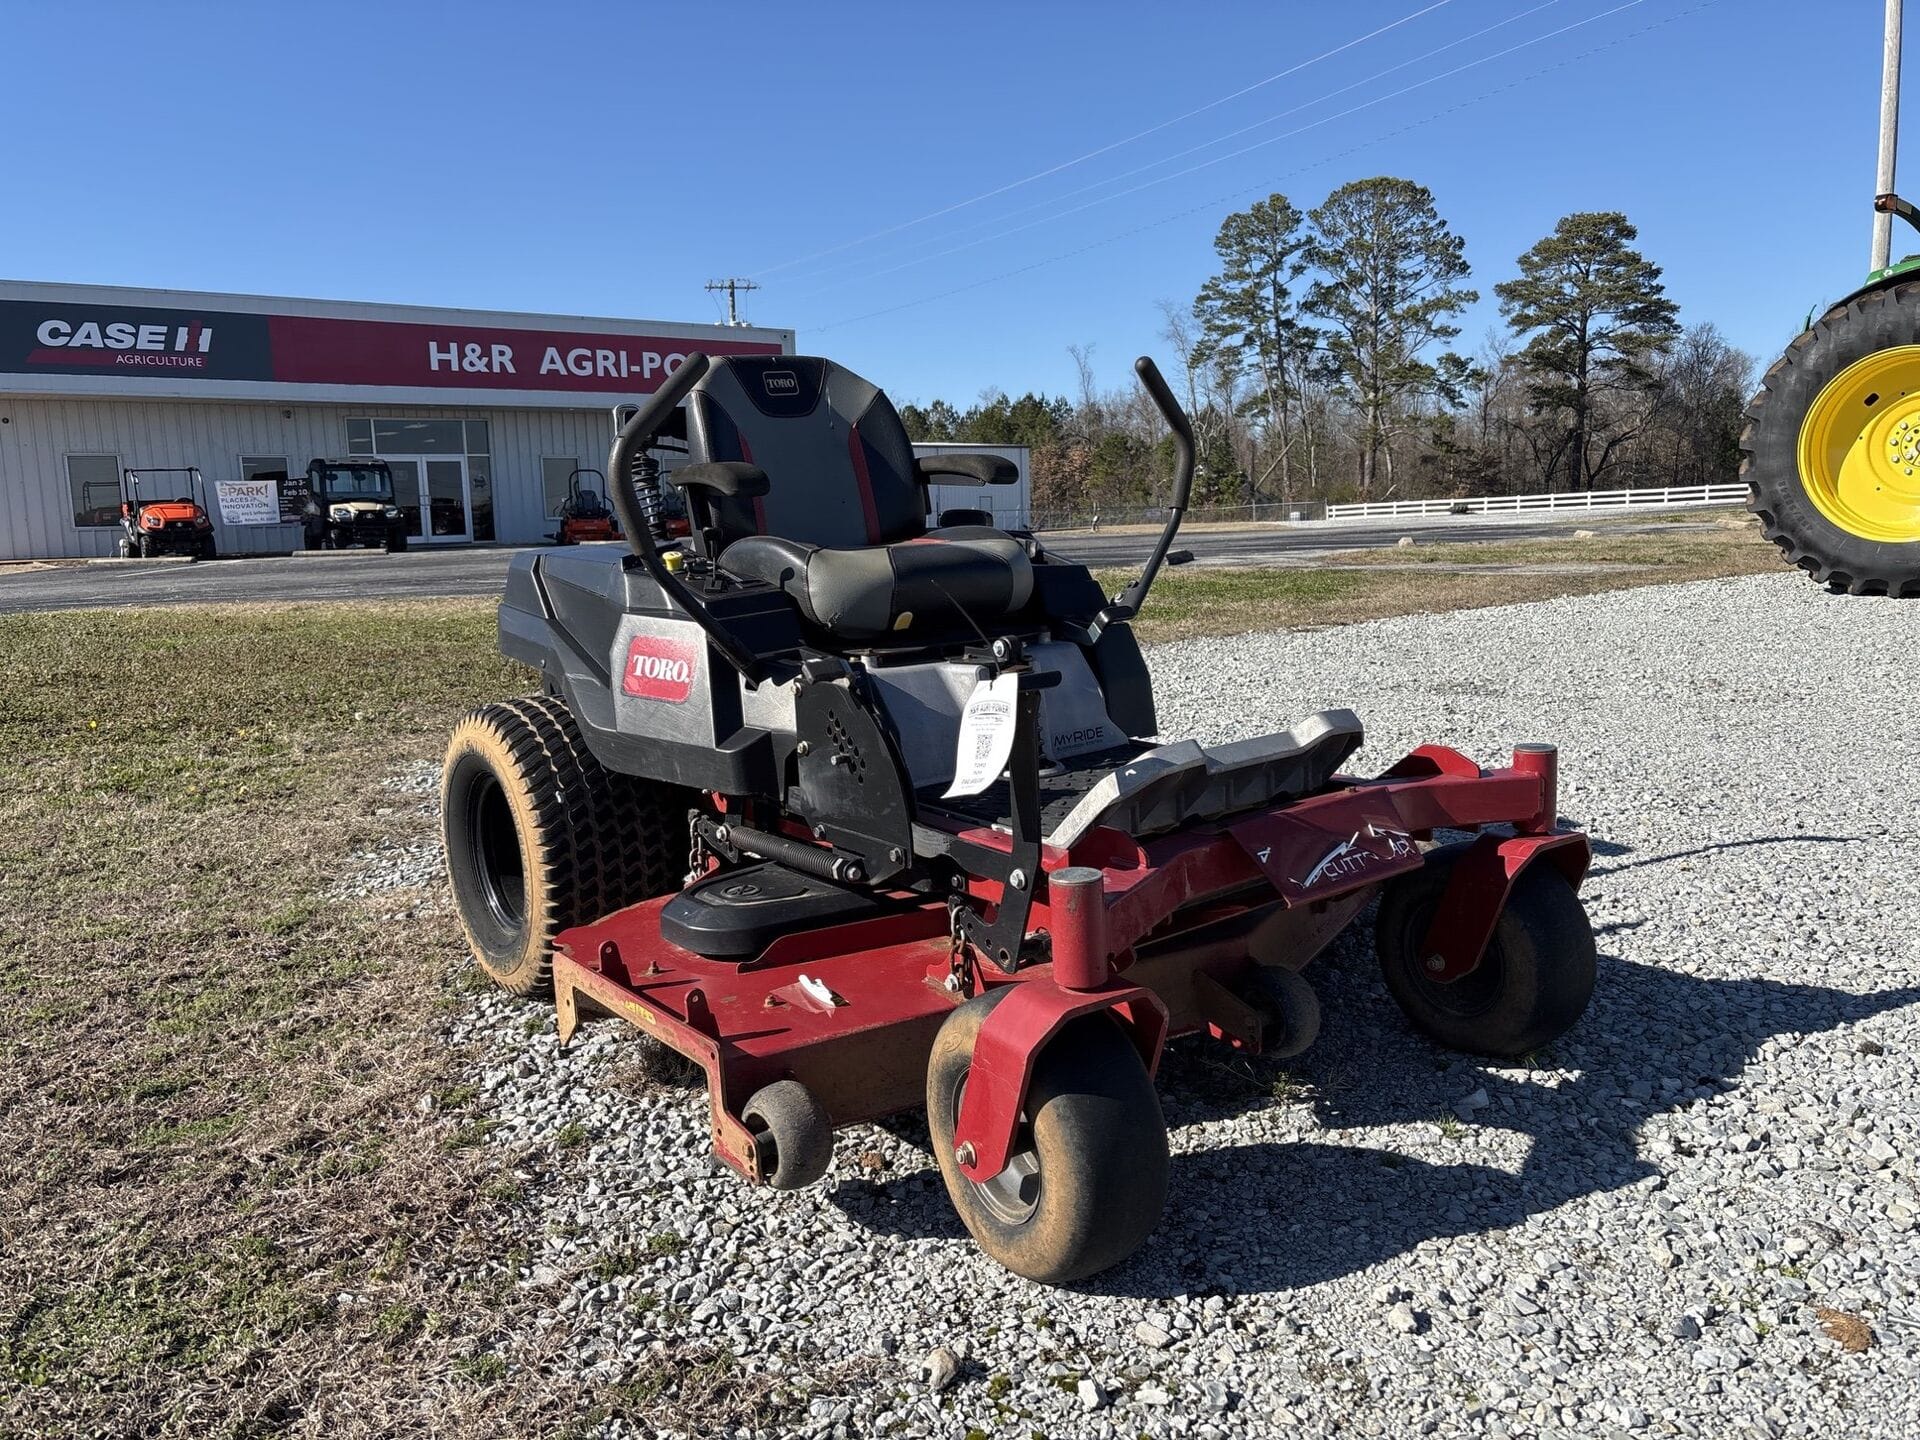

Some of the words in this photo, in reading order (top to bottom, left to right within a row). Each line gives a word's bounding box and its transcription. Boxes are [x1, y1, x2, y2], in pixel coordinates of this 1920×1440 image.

[36, 319, 169, 351] CASE
[115, 354, 202, 367] AGRICULTURE
[428, 341, 517, 374] H&R
[539, 346, 688, 379] AGRI-PO
[766, 378, 795, 389] TORO
[283, 479, 298, 487] Jan
[220, 483, 269, 498] SPARK!
[220, 496, 249, 504] PLACES
[222, 502, 269, 510] INNOVATION
